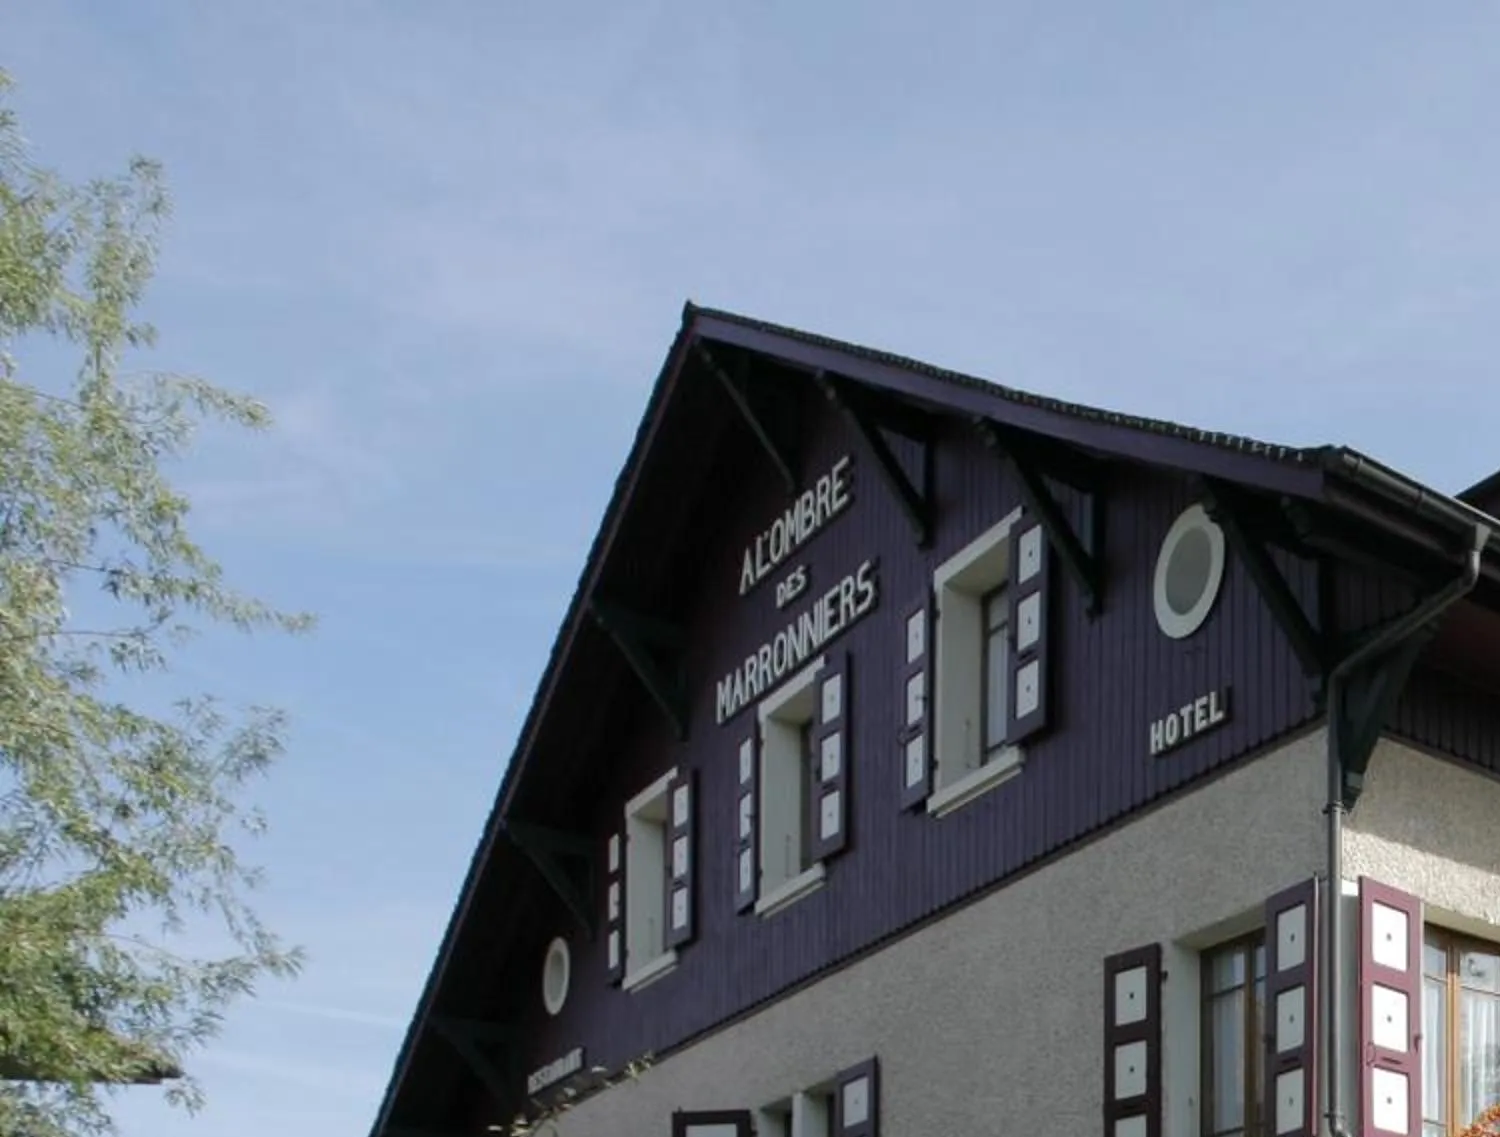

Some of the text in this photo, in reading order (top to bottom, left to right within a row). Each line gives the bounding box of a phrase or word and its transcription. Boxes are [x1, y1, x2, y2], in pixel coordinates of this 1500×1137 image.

[776, 565, 807, 609] DES
[716, 560, 876, 725] MARRONNIERS
[1150, 691, 1224, 755] HOTEL
